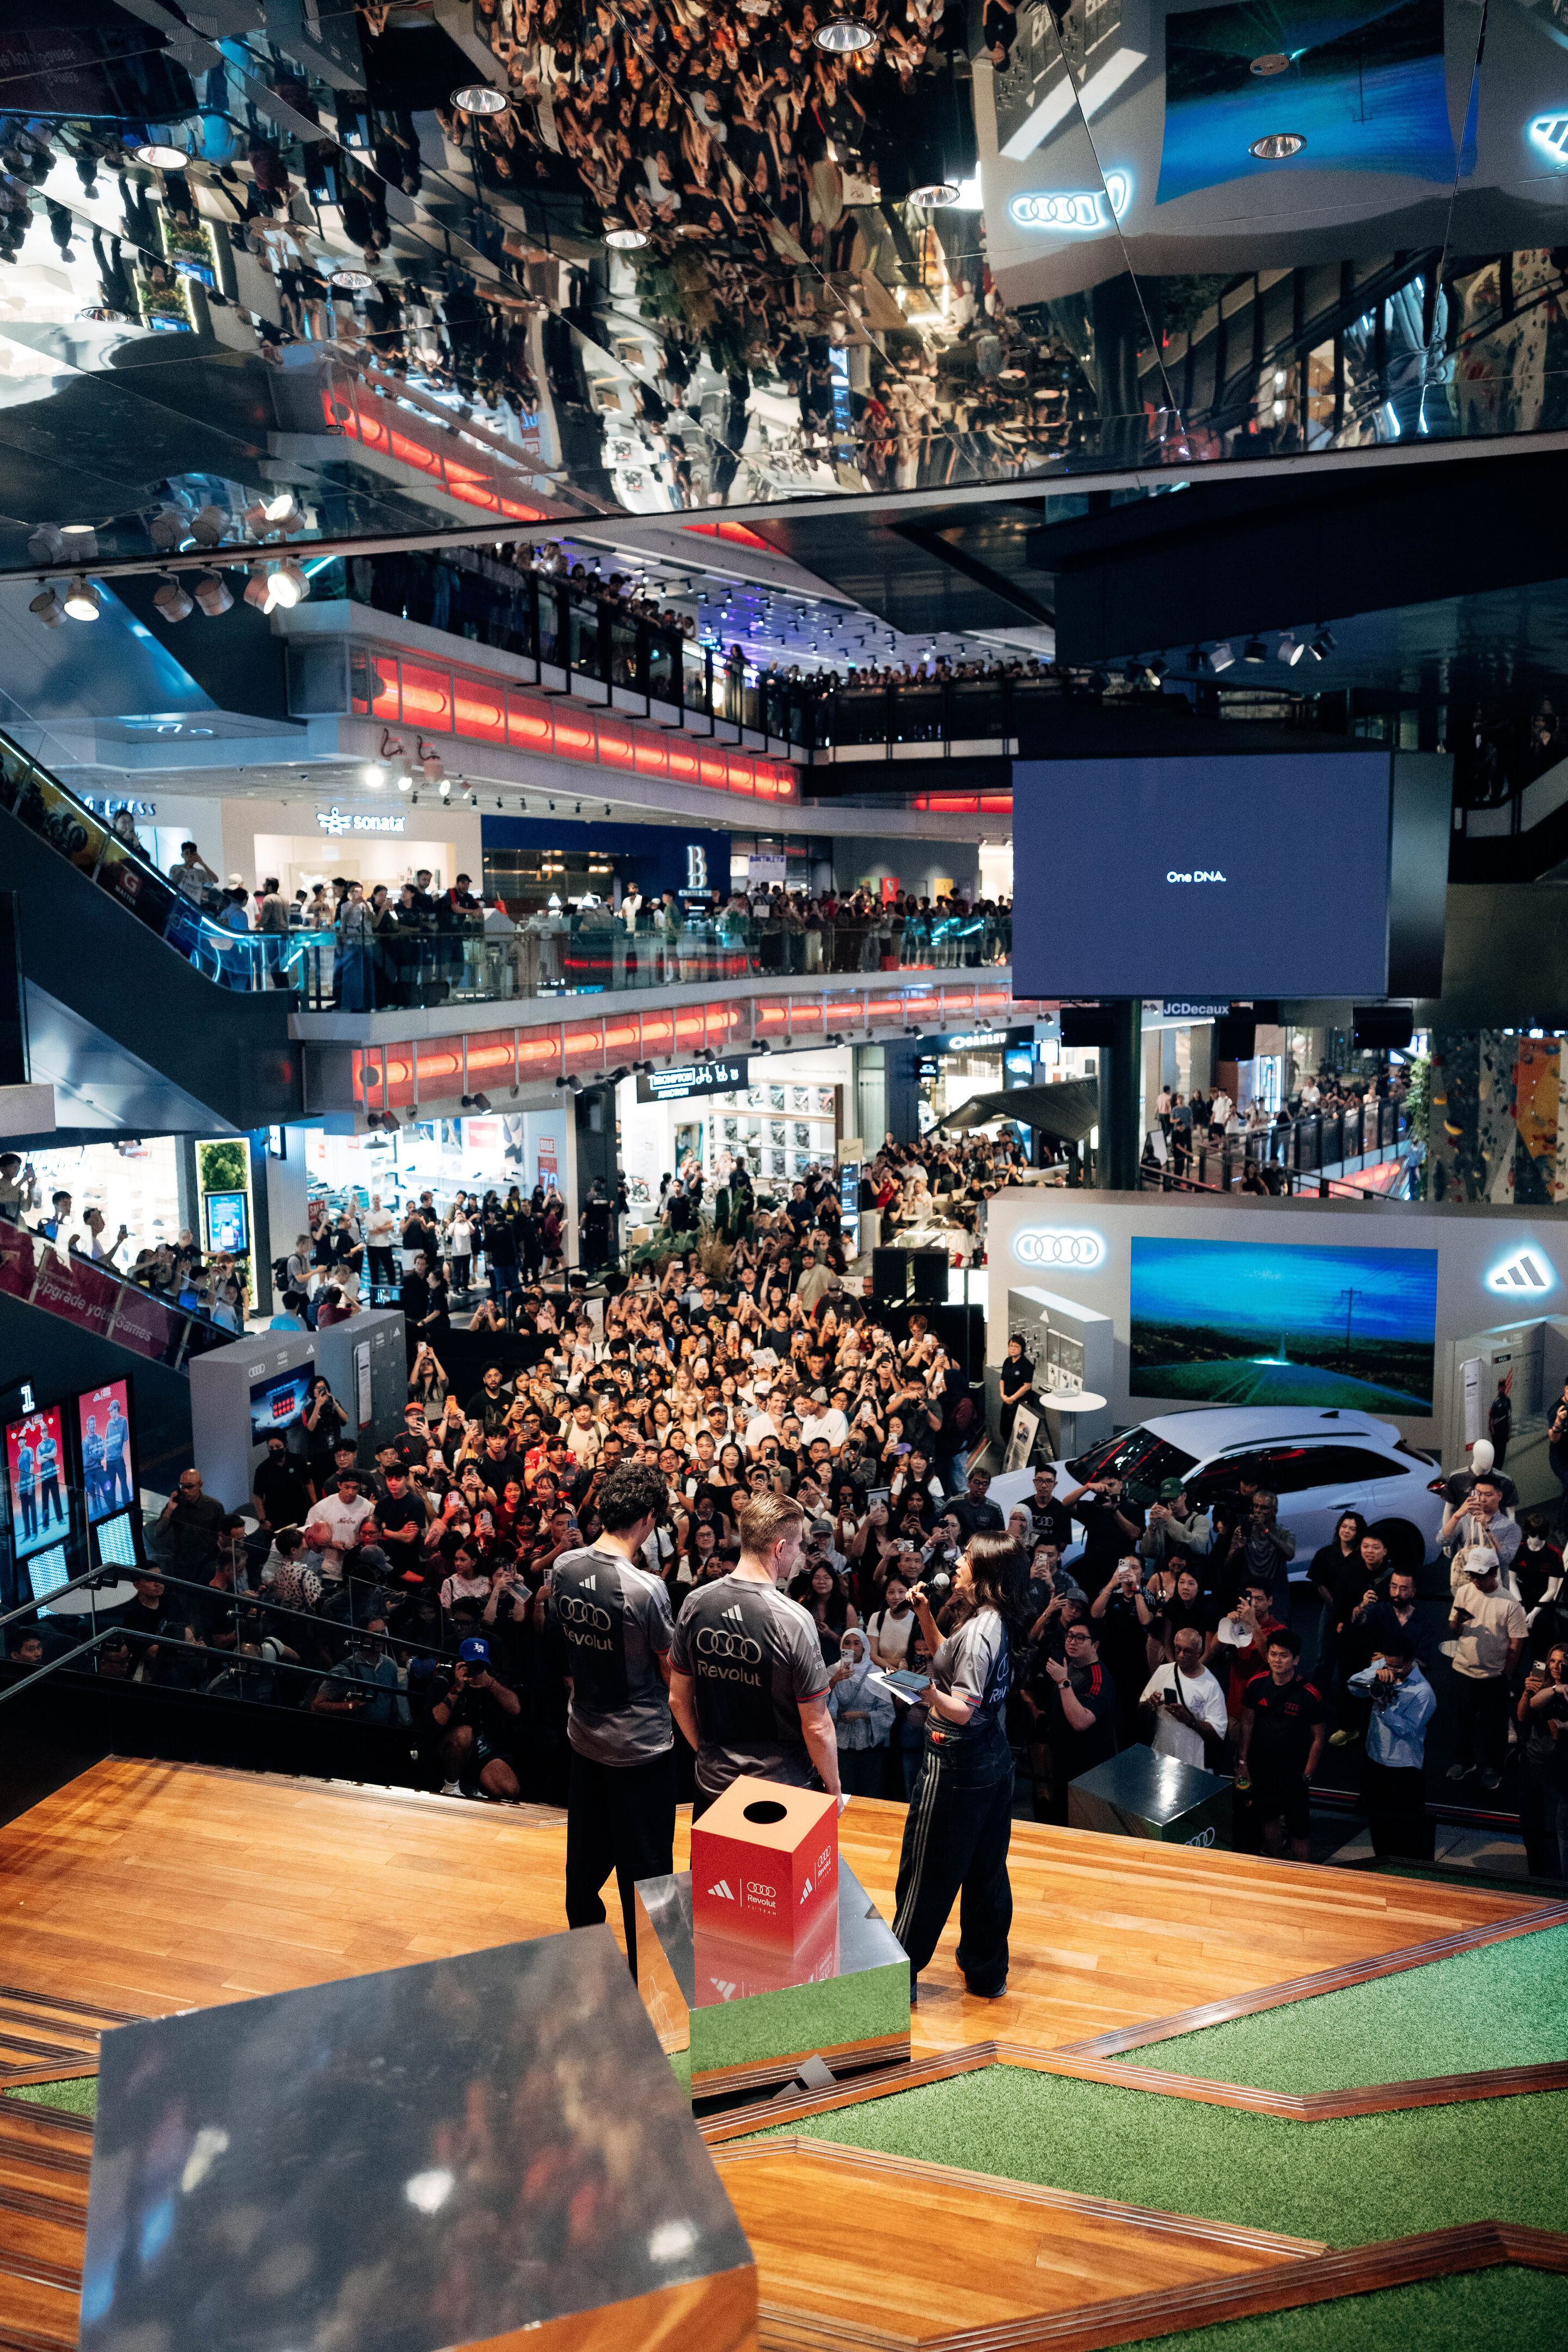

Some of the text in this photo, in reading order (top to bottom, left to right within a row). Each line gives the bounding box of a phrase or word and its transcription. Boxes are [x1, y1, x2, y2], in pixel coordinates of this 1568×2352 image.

[353, 815, 406, 832] sonata
[1167, 871, 1227, 883] One DNA.
[1164, 1003, 1229, 1014] JCDecaux
[36, 1273, 86, 1310] Upgrade
[21, 1385, 35, 1413] 1
[697, 1659, 762, 1687] Revolut
[818, 1858, 831, 1878] Revolut
[748, 1894, 776, 1908] Revolut
[759, 1908, 776, 1916] TEAM
